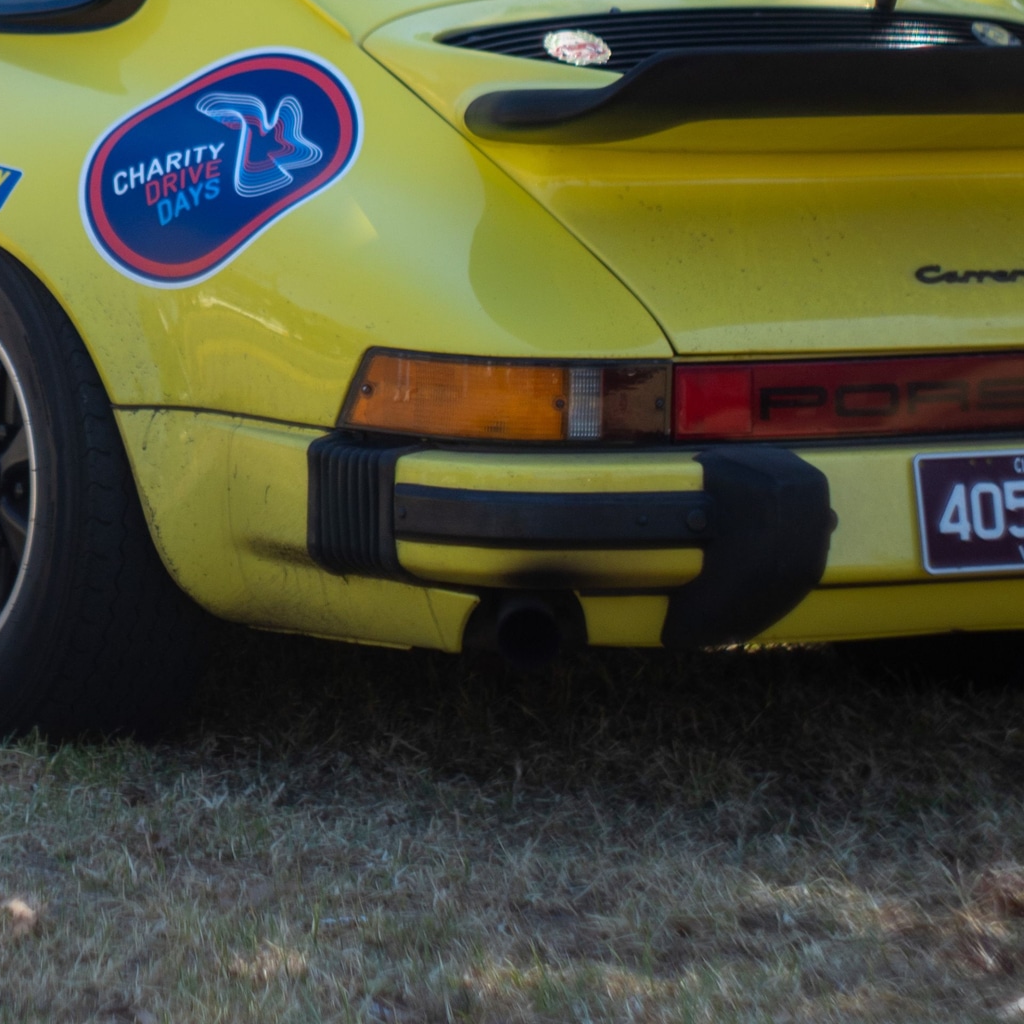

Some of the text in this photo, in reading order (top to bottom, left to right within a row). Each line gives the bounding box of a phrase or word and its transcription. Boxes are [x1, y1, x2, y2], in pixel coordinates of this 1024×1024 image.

[112, 142, 225, 196] CHARITY
[145, 159, 223, 207] DRIVE
[156, 177, 221, 227] DAYS
